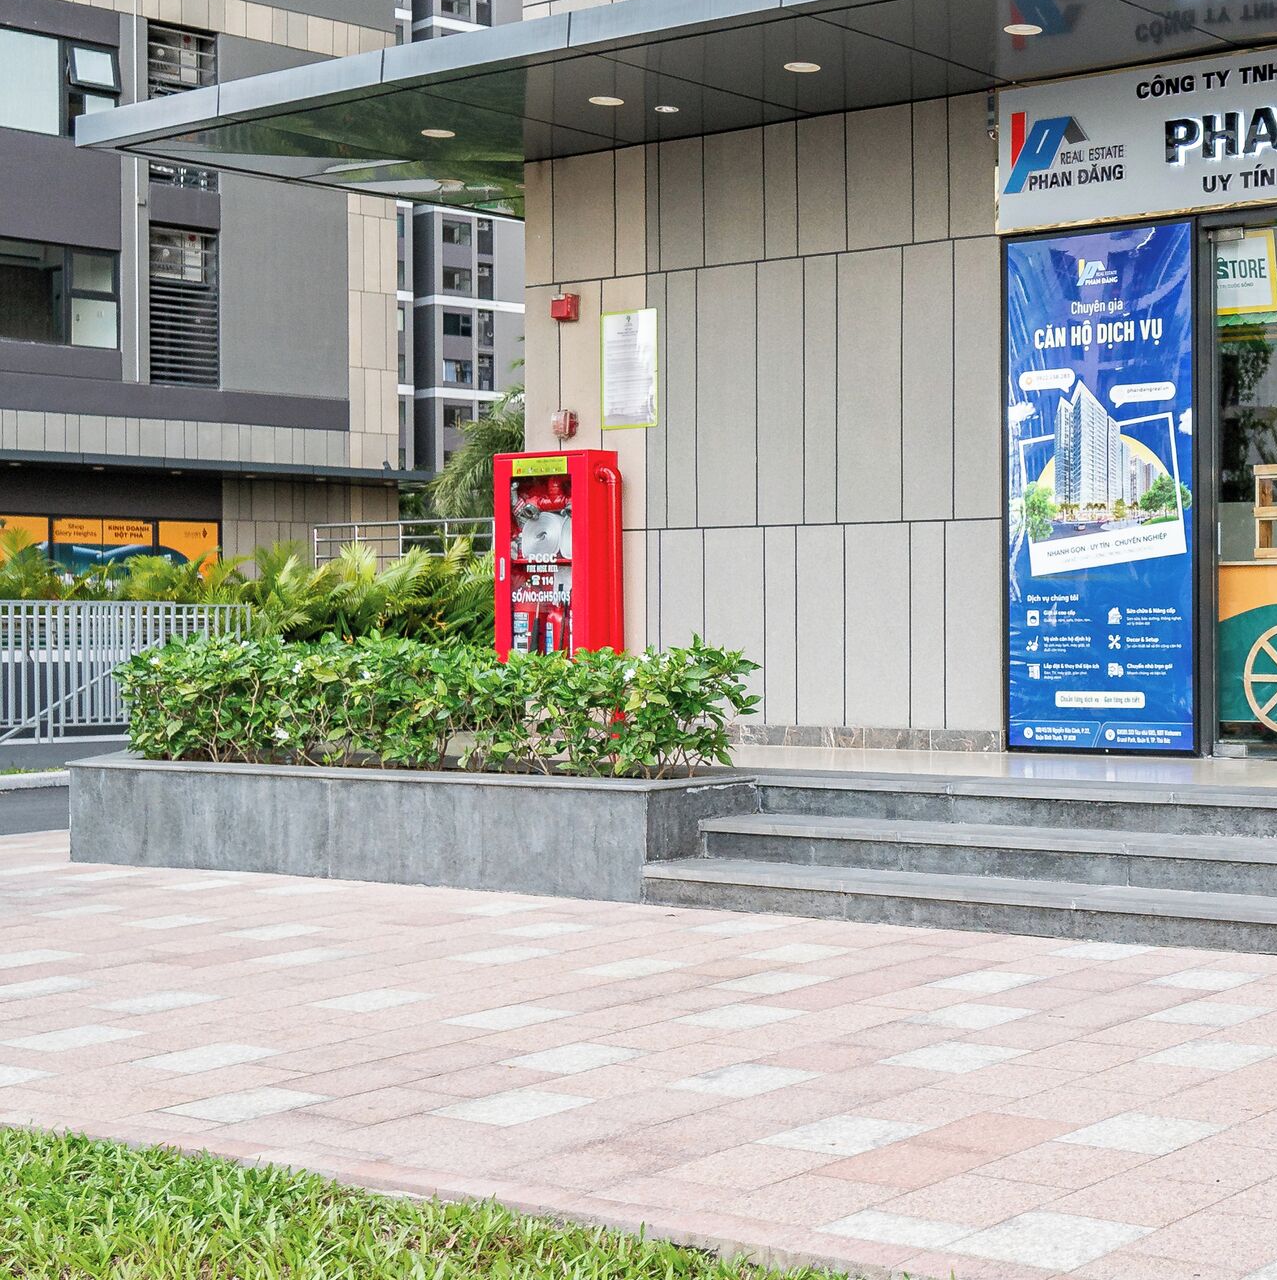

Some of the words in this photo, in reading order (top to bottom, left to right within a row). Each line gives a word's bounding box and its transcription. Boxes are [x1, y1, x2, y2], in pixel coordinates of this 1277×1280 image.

[1136, 75, 1195, 99] CÔNG
[1203, 70, 1231, 89] TY
[1060, 152, 1084, 165] REAL
[1089, 145, 1124, 161] ESTATE
[1029, 171, 1072, 191] PHAN
[1078, 164, 1124, 185] ĐĂNG
[1203, 174, 1232, 192] UY
[1240, 163, 1275, 189] TÍN
[1071, 299, 1105, 316] Chuyên
[1108, 297, 1123, 314] gia
[1034, 323, 1066, 349] CĂN
[1071, 320, 1092, 352] HỘ
[1097, 321, 1134, 349] DỊCH
[1140, 318, 1162, 345] VỤ
[68, 523, 84, 531] Shop
[114, 531, 129, 539] ĐỘT
[1047, 548, 1070, 557] NHANH
[1090, 543, 1098, 551] UY
[528, 553, 557, 564] PCCC
[541, 576, 553, 586] 114
[1027, 594, 1041, 603] Dịch
